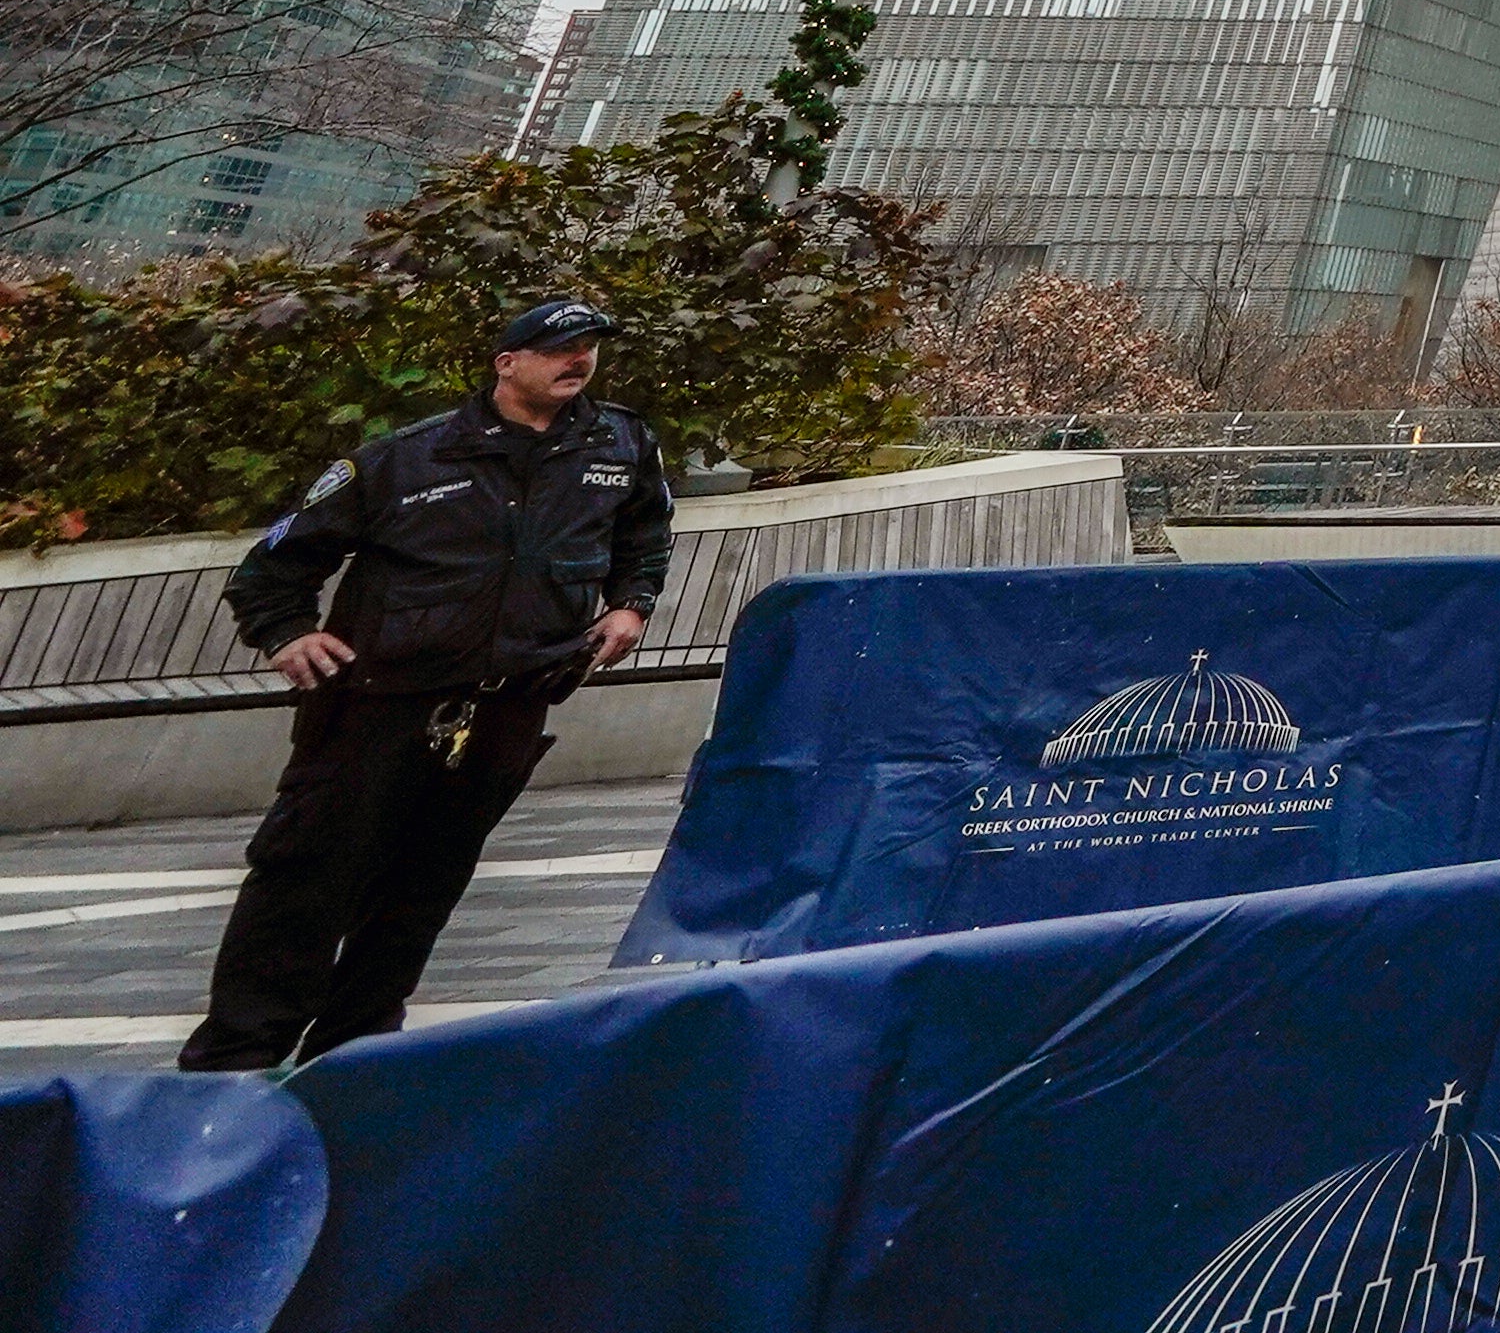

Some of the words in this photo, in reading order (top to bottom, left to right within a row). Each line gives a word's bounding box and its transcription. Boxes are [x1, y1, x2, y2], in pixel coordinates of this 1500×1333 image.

[582, 472, 630, 486] POLICE
[970, 779, 1105, 811] SAINT
[1125, 764, 1342, 801] NICHOLAS
[962, 819, 1013, 837] GREEK
[1016, 812, 1111, 831] ORTHODOX
[1112, 808, 1181, 824] CHURCH
[1184, 807, 1196, 820] &
[1200, 800, 1275, 819] NATIONAL
[1277, 798, 1334, 814] SHRINE
[1026, 842, 1045, 852] AT
[1053, 839, 1082, 851] THE
[1090, 835, 1144, 847] WORLD
[1151, 831, 1197, 842] TRADE
[1204, 826, 1260, 838] CENTER
